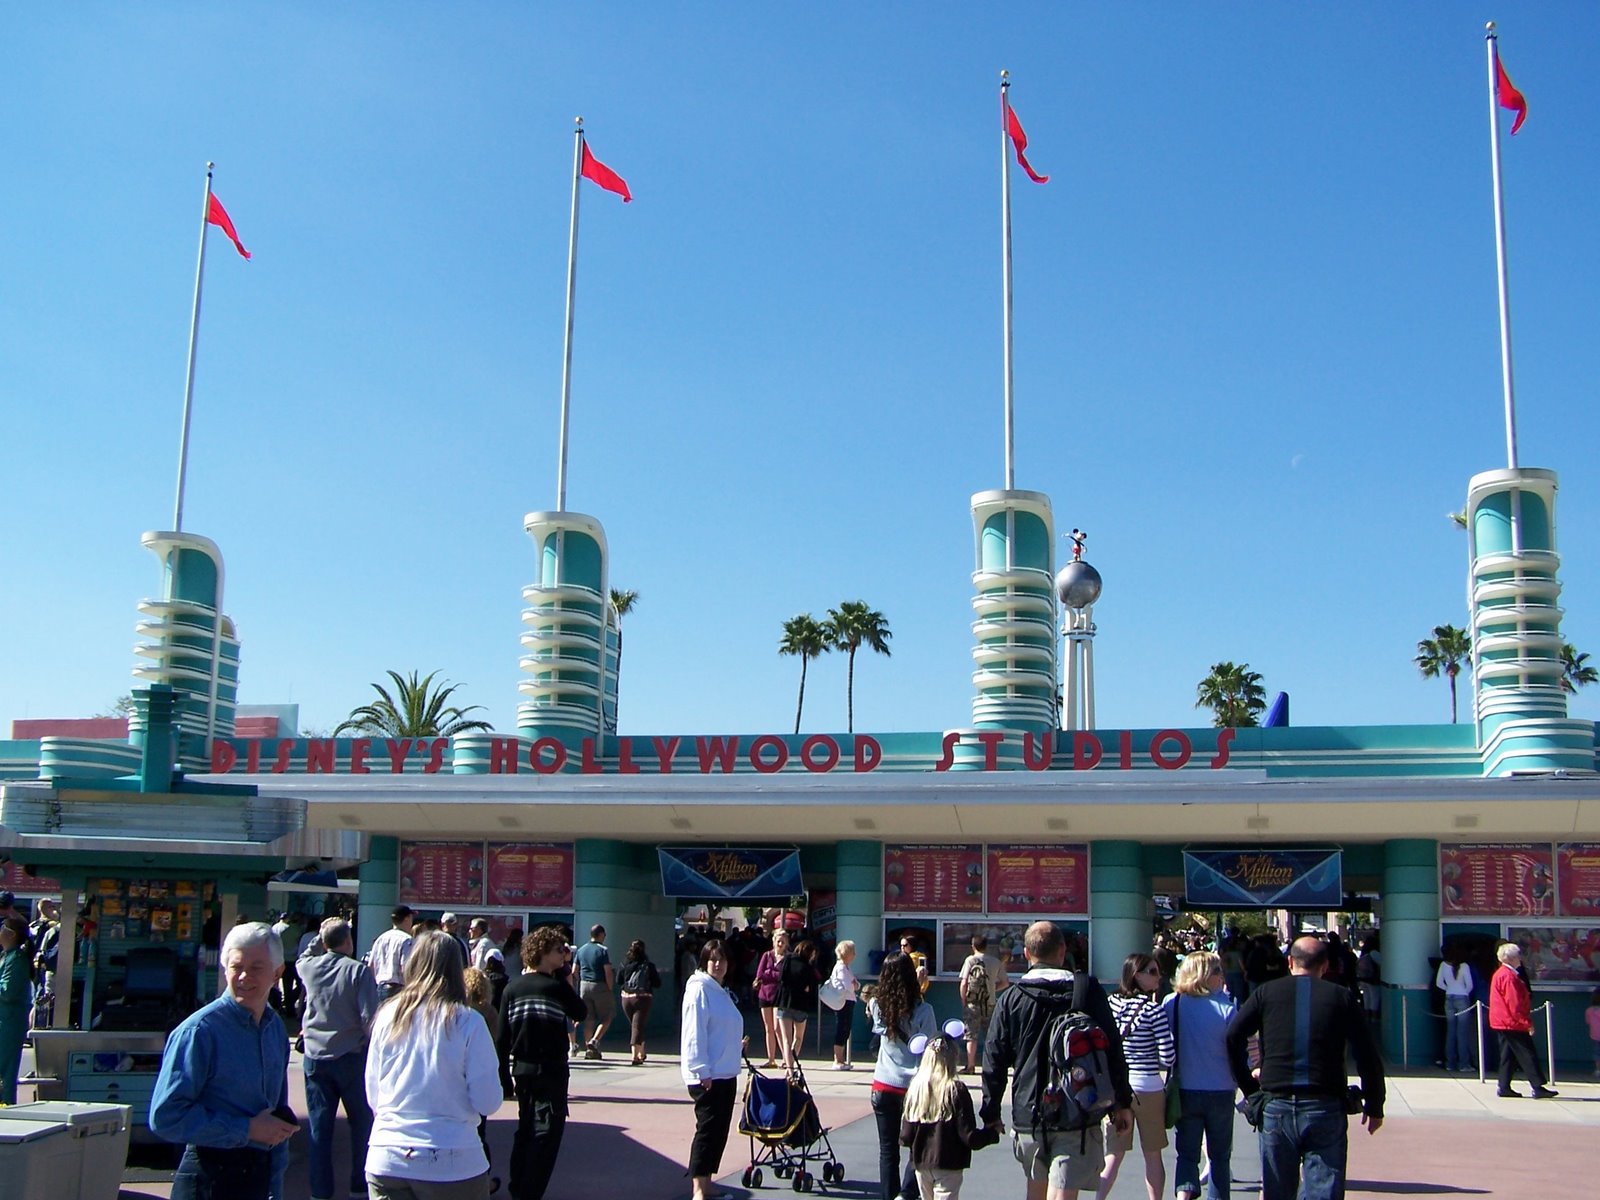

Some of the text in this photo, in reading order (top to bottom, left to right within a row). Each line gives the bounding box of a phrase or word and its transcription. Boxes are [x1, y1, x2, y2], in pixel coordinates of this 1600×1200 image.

[210, 728, 1236, 774] DISNEY'S HOLLYWOOD STUDIOS
[697, 858, 757, 875] Million
[1225, 862, 1293, 879] Million
